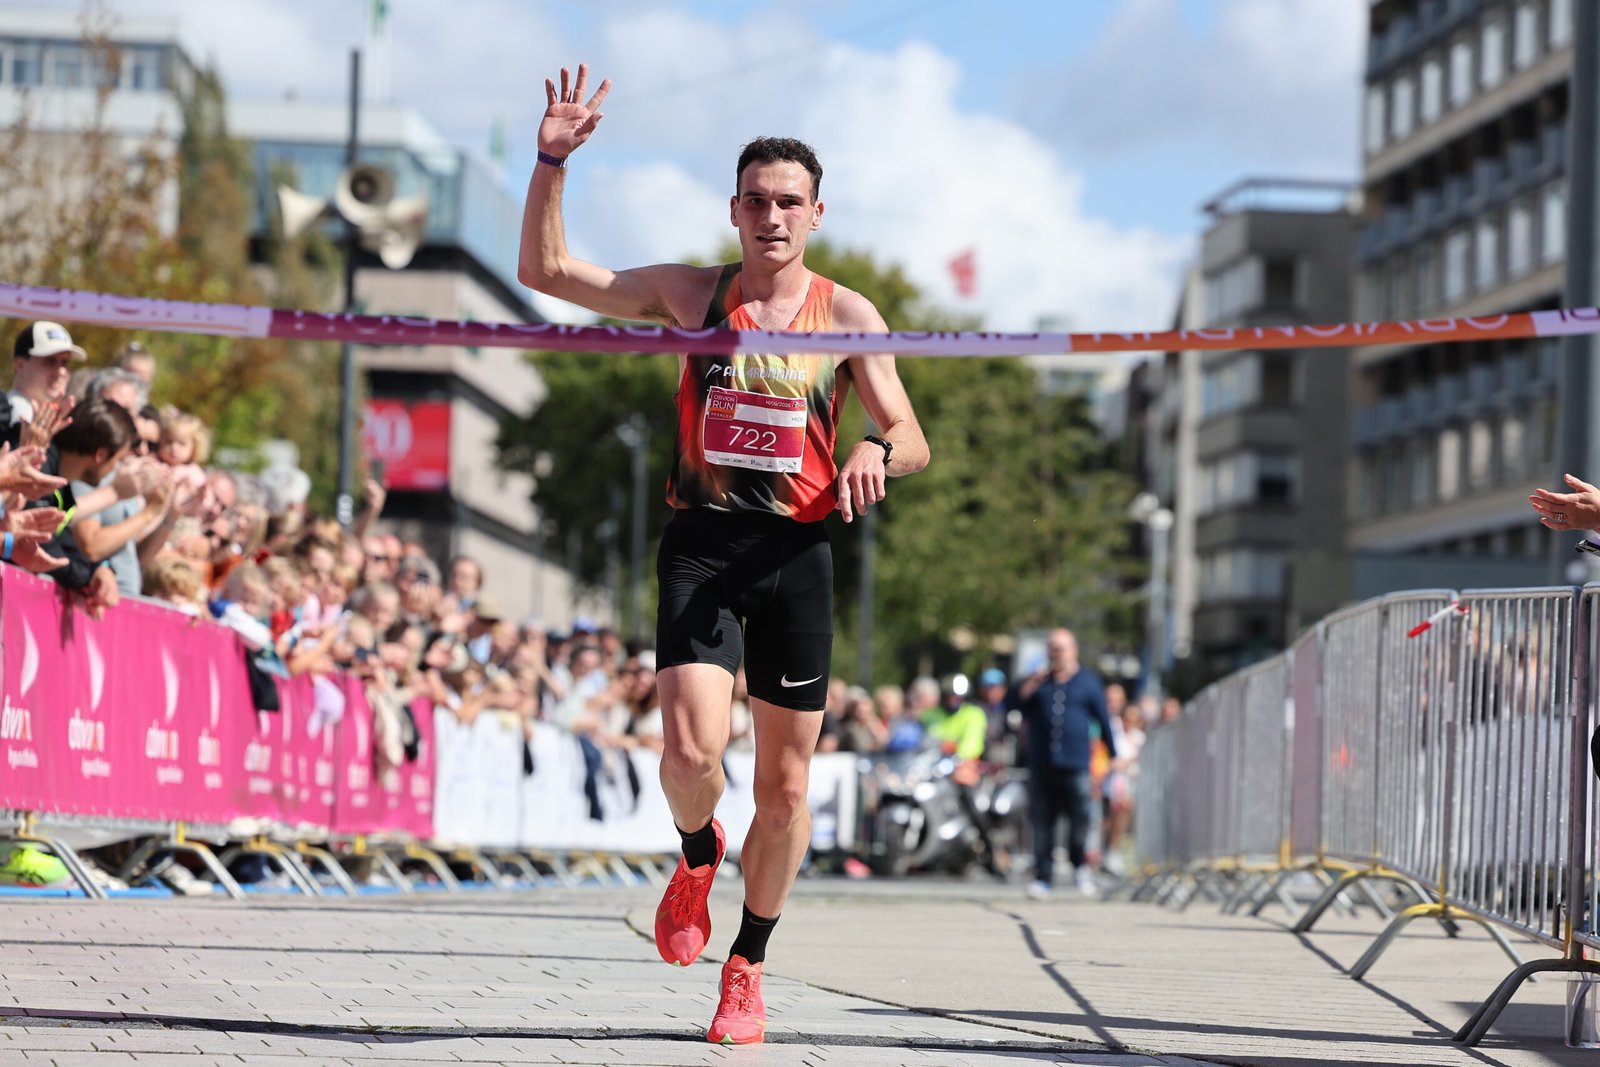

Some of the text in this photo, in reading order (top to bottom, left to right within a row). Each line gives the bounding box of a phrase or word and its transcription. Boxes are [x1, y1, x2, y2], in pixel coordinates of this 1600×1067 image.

[723, 365, 806, 381] AL4RUNNING
[712, 400, 735, 410] RUN
[714, 394, 735, 403] OBVION
[728, 425, 777, 452] 722
